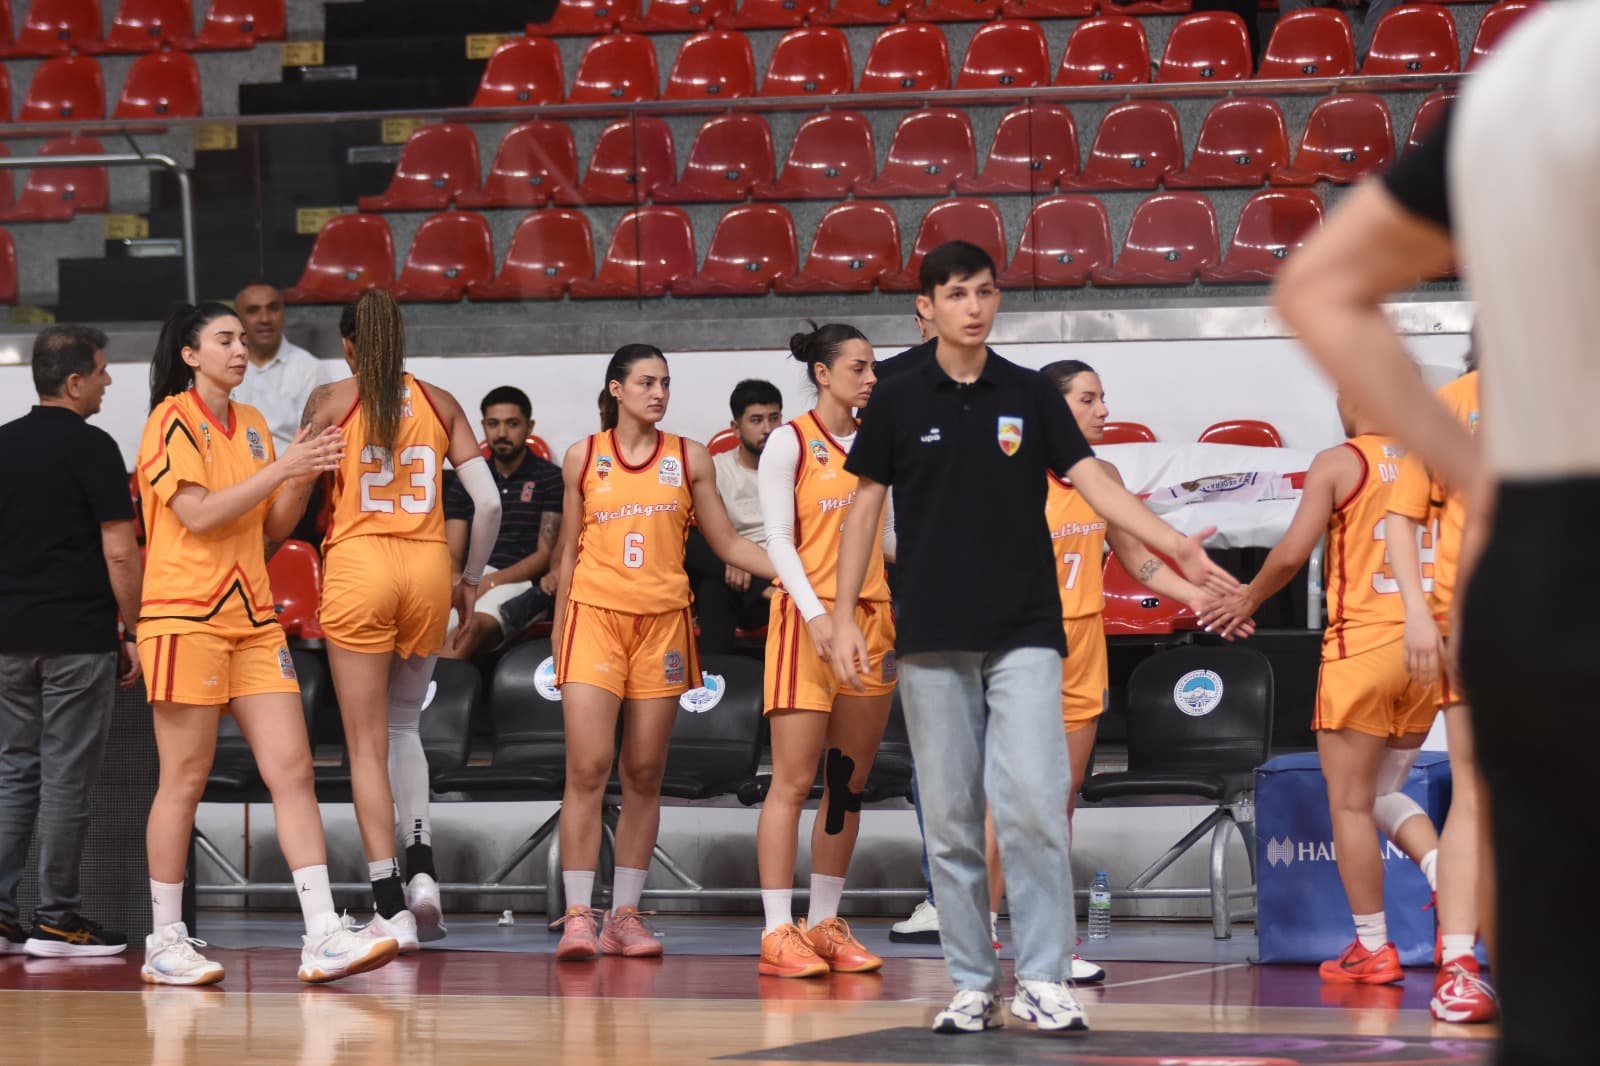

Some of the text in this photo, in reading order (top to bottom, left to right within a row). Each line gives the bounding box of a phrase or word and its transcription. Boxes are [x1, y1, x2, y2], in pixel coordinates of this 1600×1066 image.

[360, 445, 437, 514] 23
[623, 531, 644, 568] 6
[1063, 552, 1081, 590] 7
